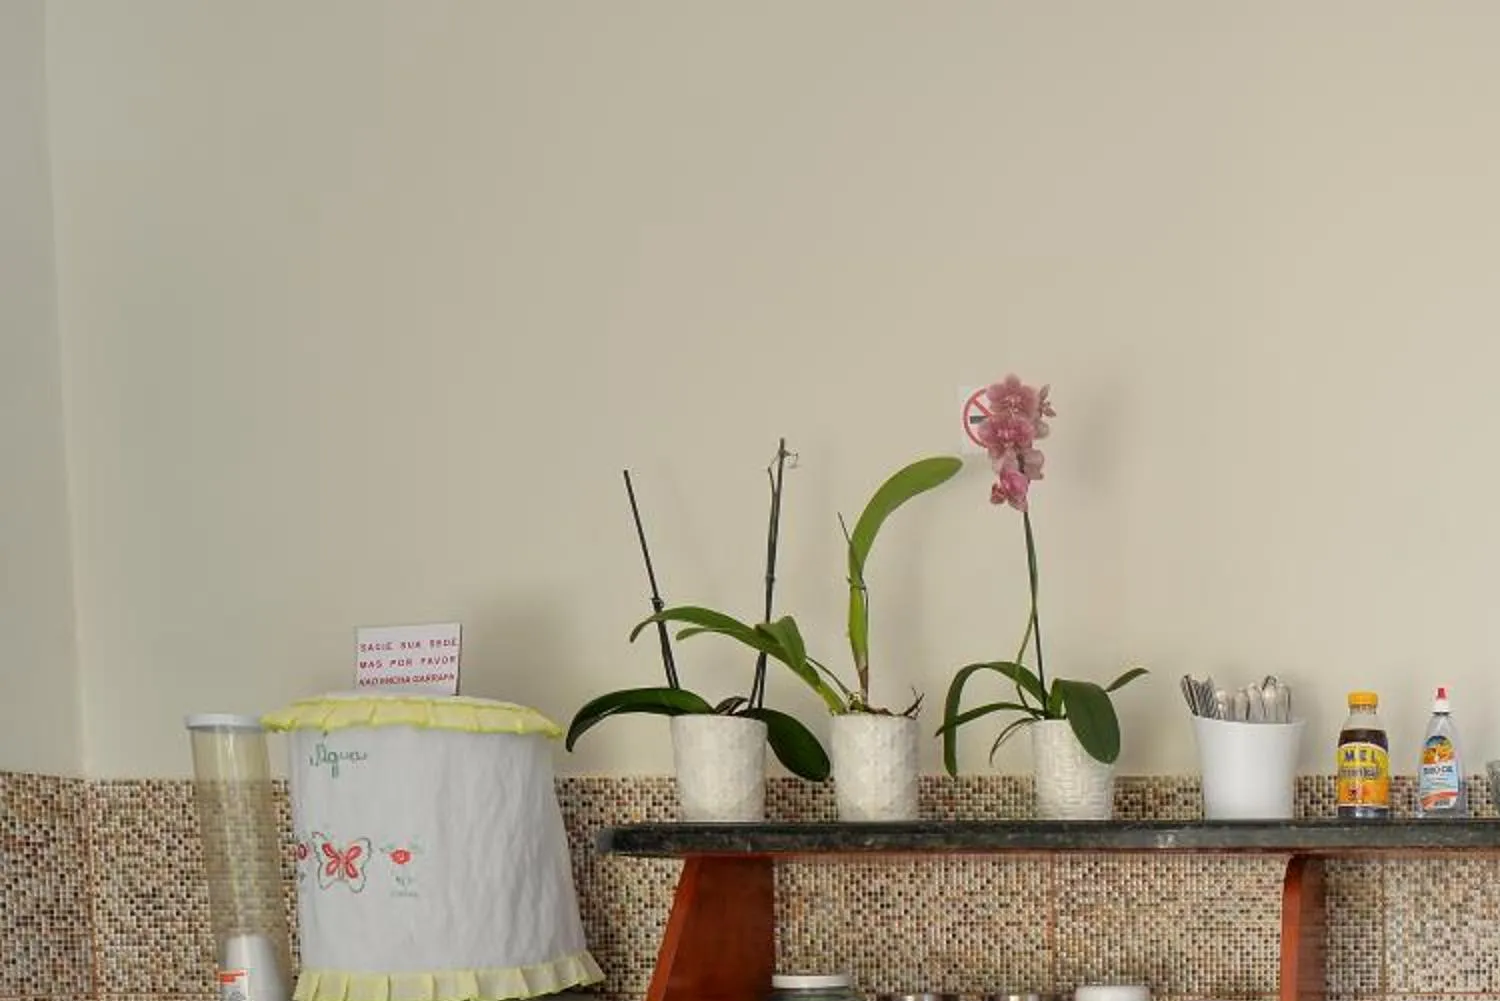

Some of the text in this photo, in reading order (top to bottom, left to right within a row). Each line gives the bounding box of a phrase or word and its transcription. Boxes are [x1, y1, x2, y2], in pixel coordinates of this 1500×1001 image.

[400, 640, 421, 650] SUA
[359, 655, 457, 669] MAS POR FAVOR
[1344, 748, 1377, 763] MEL
